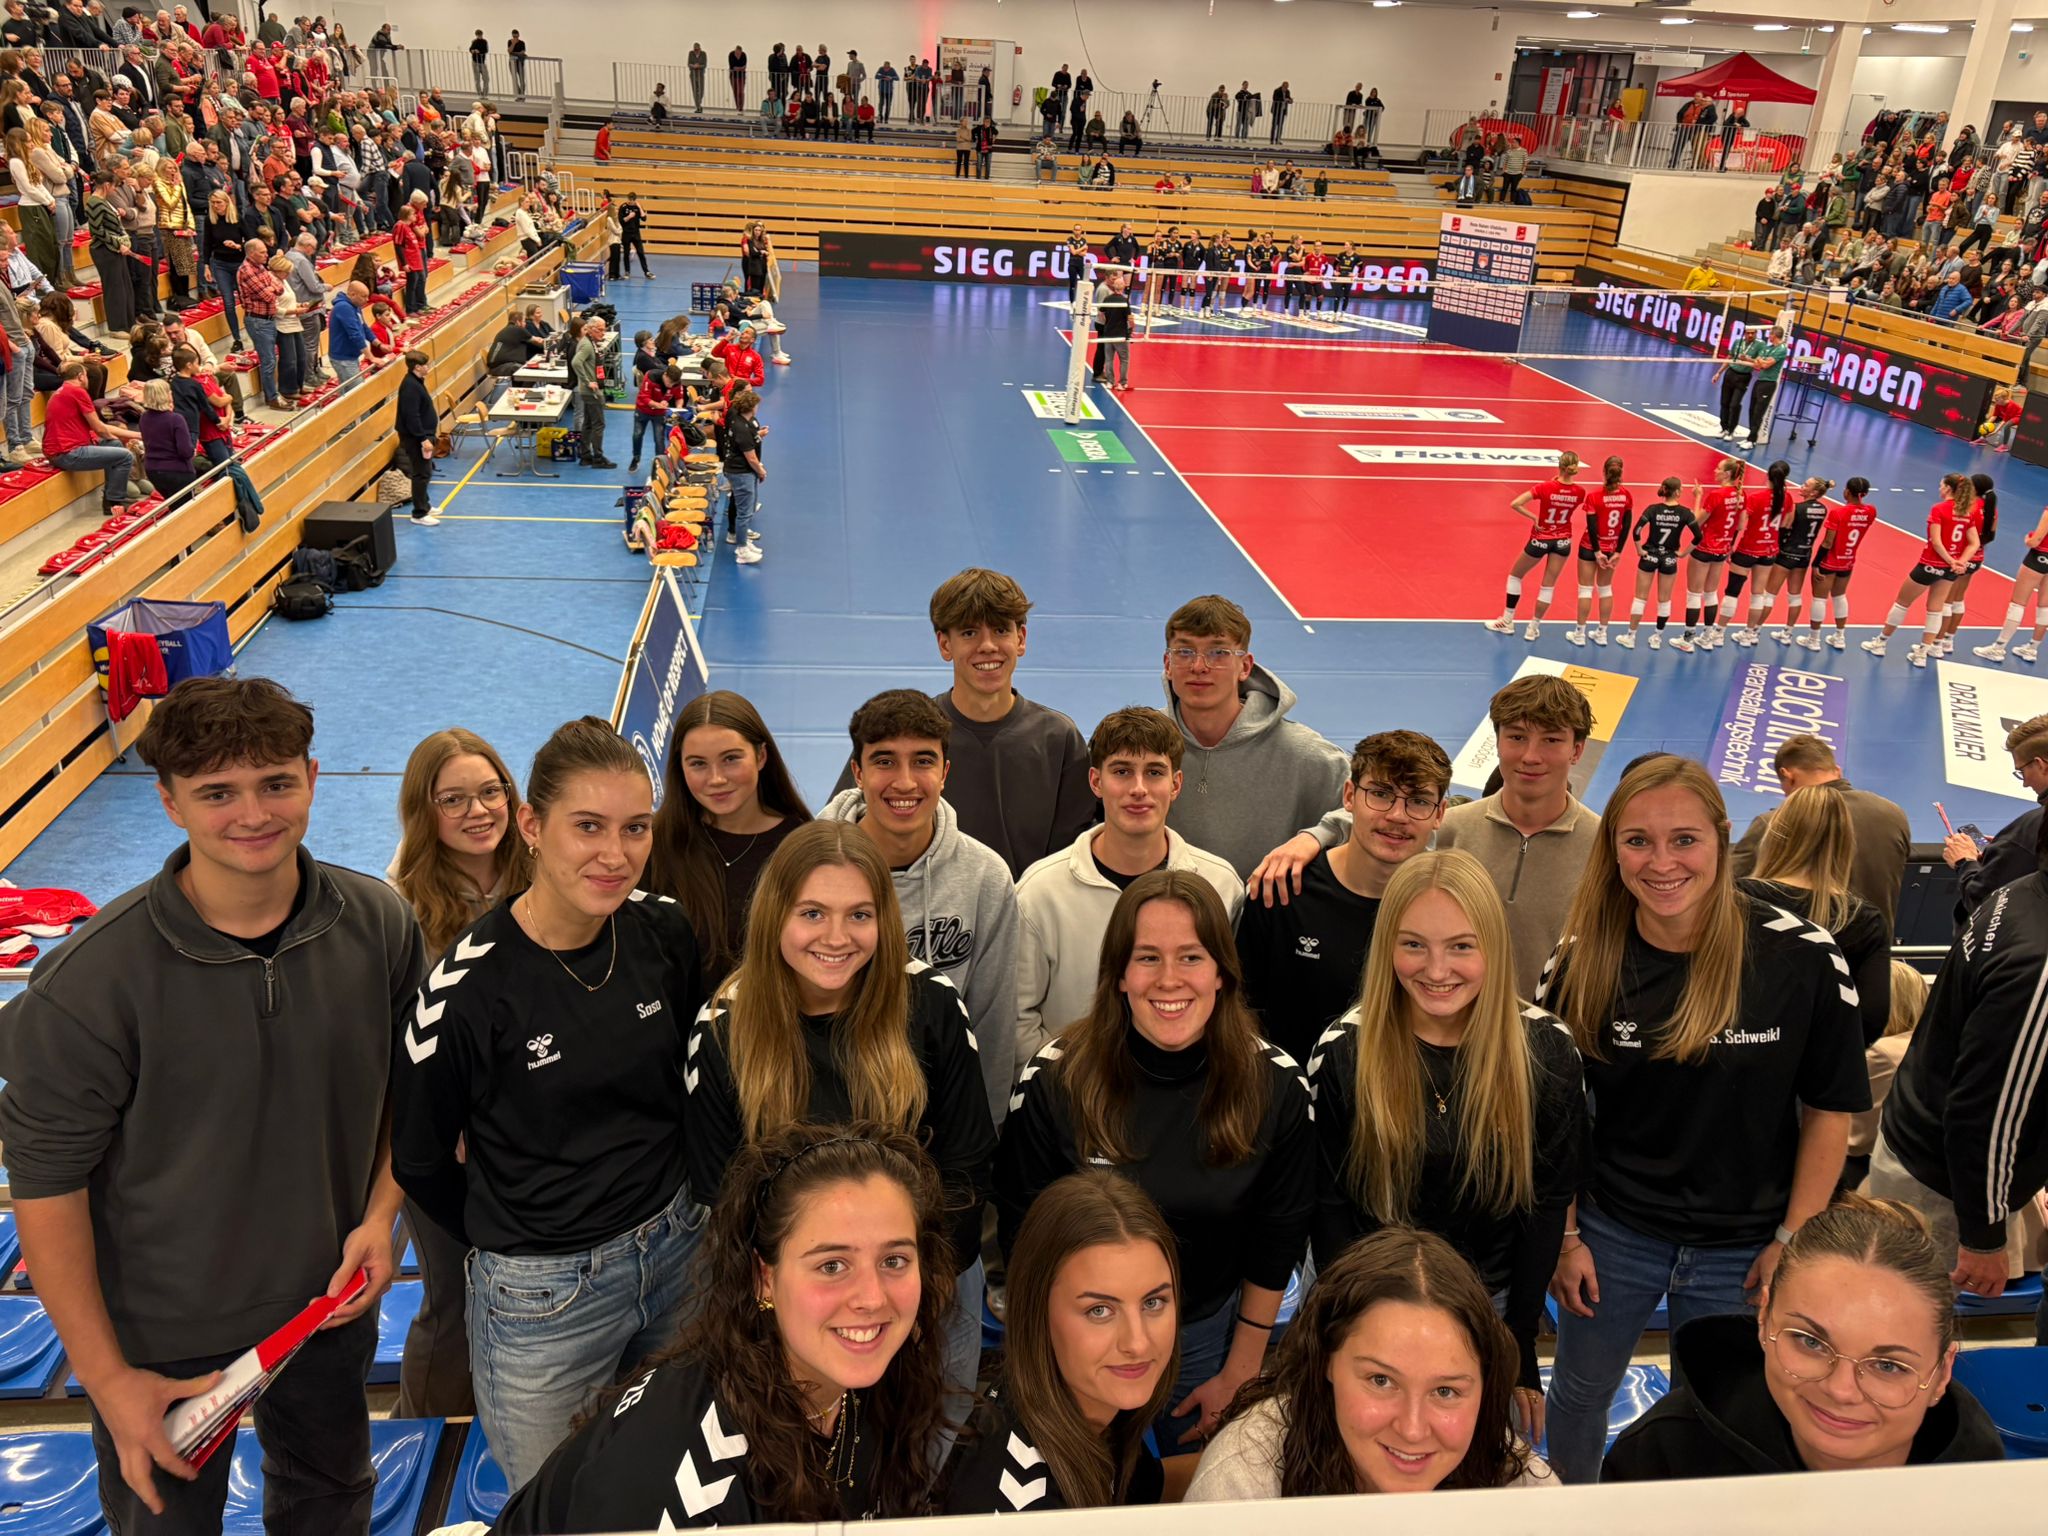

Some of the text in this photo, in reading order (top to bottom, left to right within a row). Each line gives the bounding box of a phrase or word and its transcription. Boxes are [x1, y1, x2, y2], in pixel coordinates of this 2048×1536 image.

[934, 246, 1014, 277] SIEG
[1595, 282, 1638, 319] SIEG
[1640, 293, 1682, 333] FÜR
[1685, 308, 1724, 346] DIE
[1818, 346, 1923, 411] RABEN
[1544, 508, 1569, 524] 11
[1608, 510, 1620, 528] 8
[1724, 511, 1736, 529] 5
[1759, 513, 1781, 532] 14
[1658, 528, 1672, 545] 7
[1807, 521, 1818, 537] 1
[1846, 529, 1860, 547] 9
[1951, 524, 1964, 542] 6
[1531, 538, 1548, 549] One
[1924, 565, 1945, 576] One
[651, 700, 670, 760] HOME
[667, 628, 688, 696] RESPECT
[1718, 663, 1770, 786] veranstaltungstechnik
[636, 1000, 662, 1020] Soso
[1612, 1038, 1642, 1049] hummel
[1725, 1027, 1780, 1044] Schweikl
[527, 1050, 561, 1071] hummel
